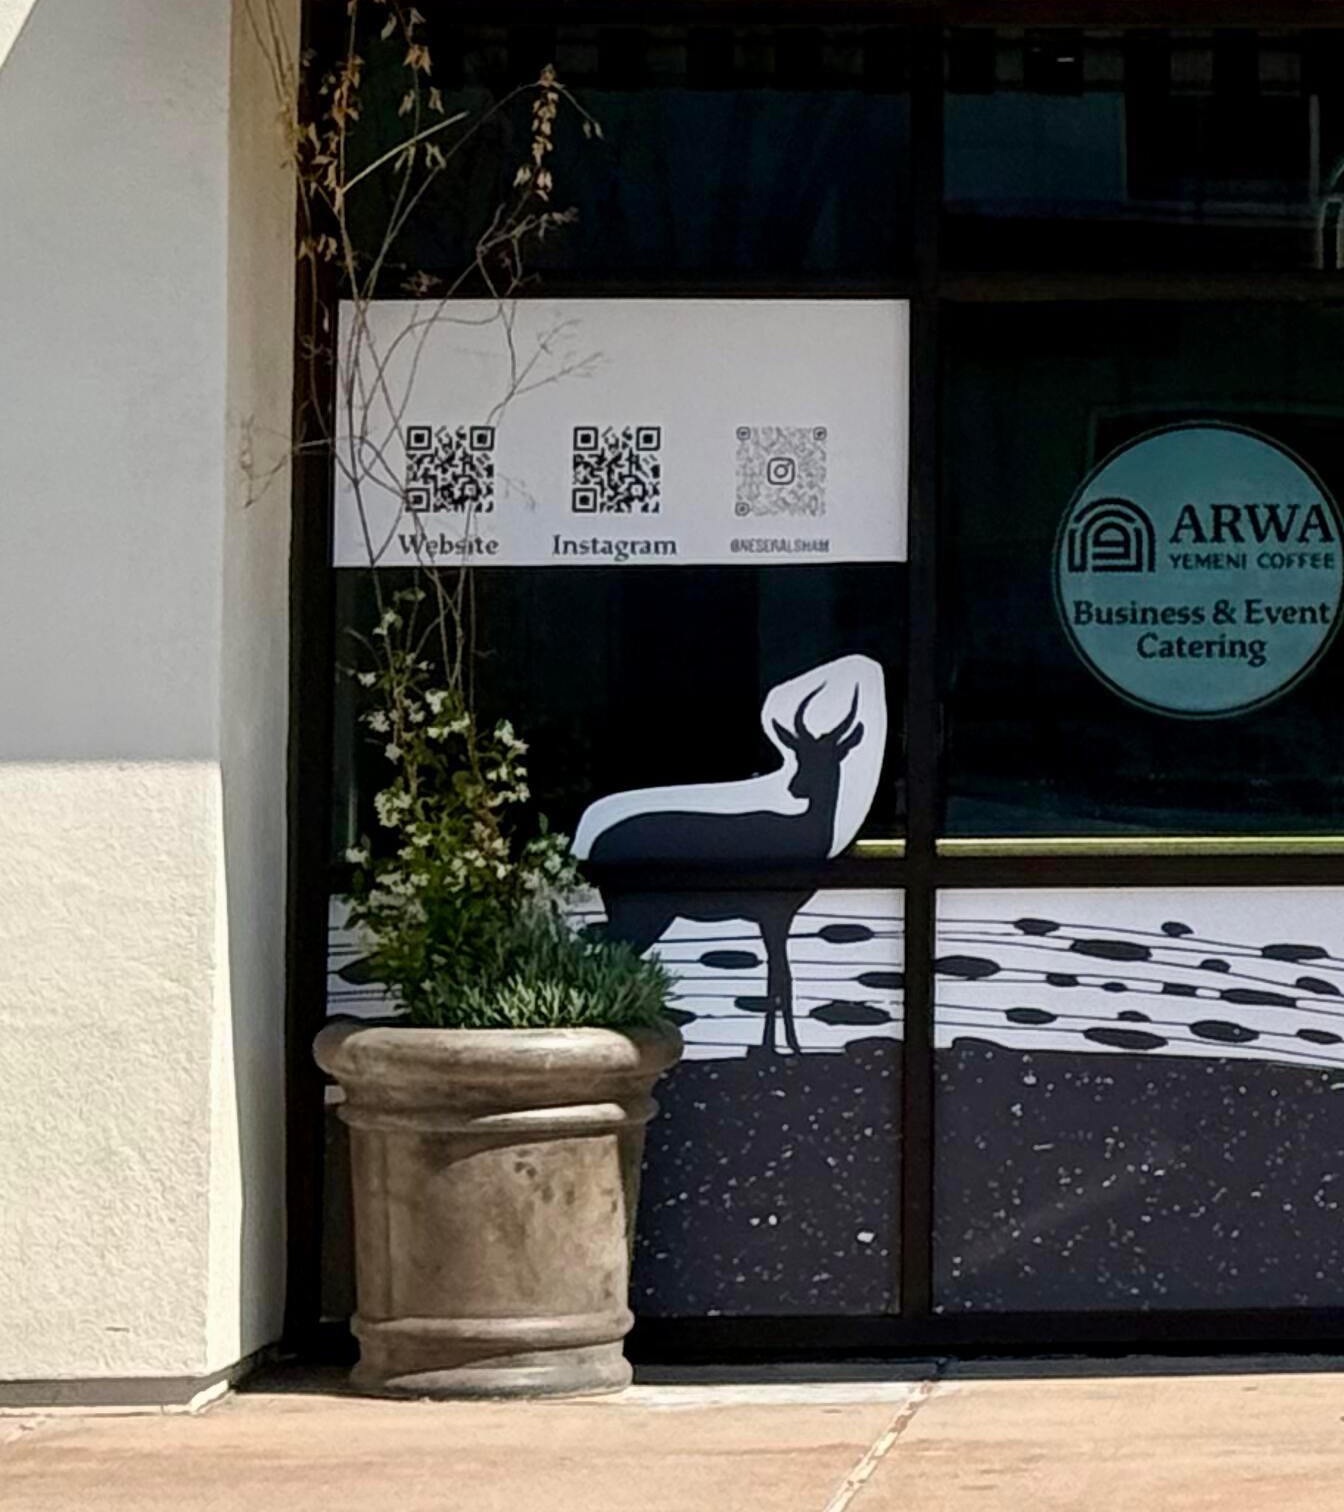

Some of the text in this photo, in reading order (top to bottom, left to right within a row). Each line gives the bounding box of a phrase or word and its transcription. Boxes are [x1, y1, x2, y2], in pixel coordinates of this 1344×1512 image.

[1168, 503, 1335, 544] ARWA
[397, 533, 678, 562] Website Instagram
[1168, 552, 1336, 570] YEMENI COFFEE
[1073, 599, 1332, 626] Business & Event
[1137, 632, 1267, 668] Catering
